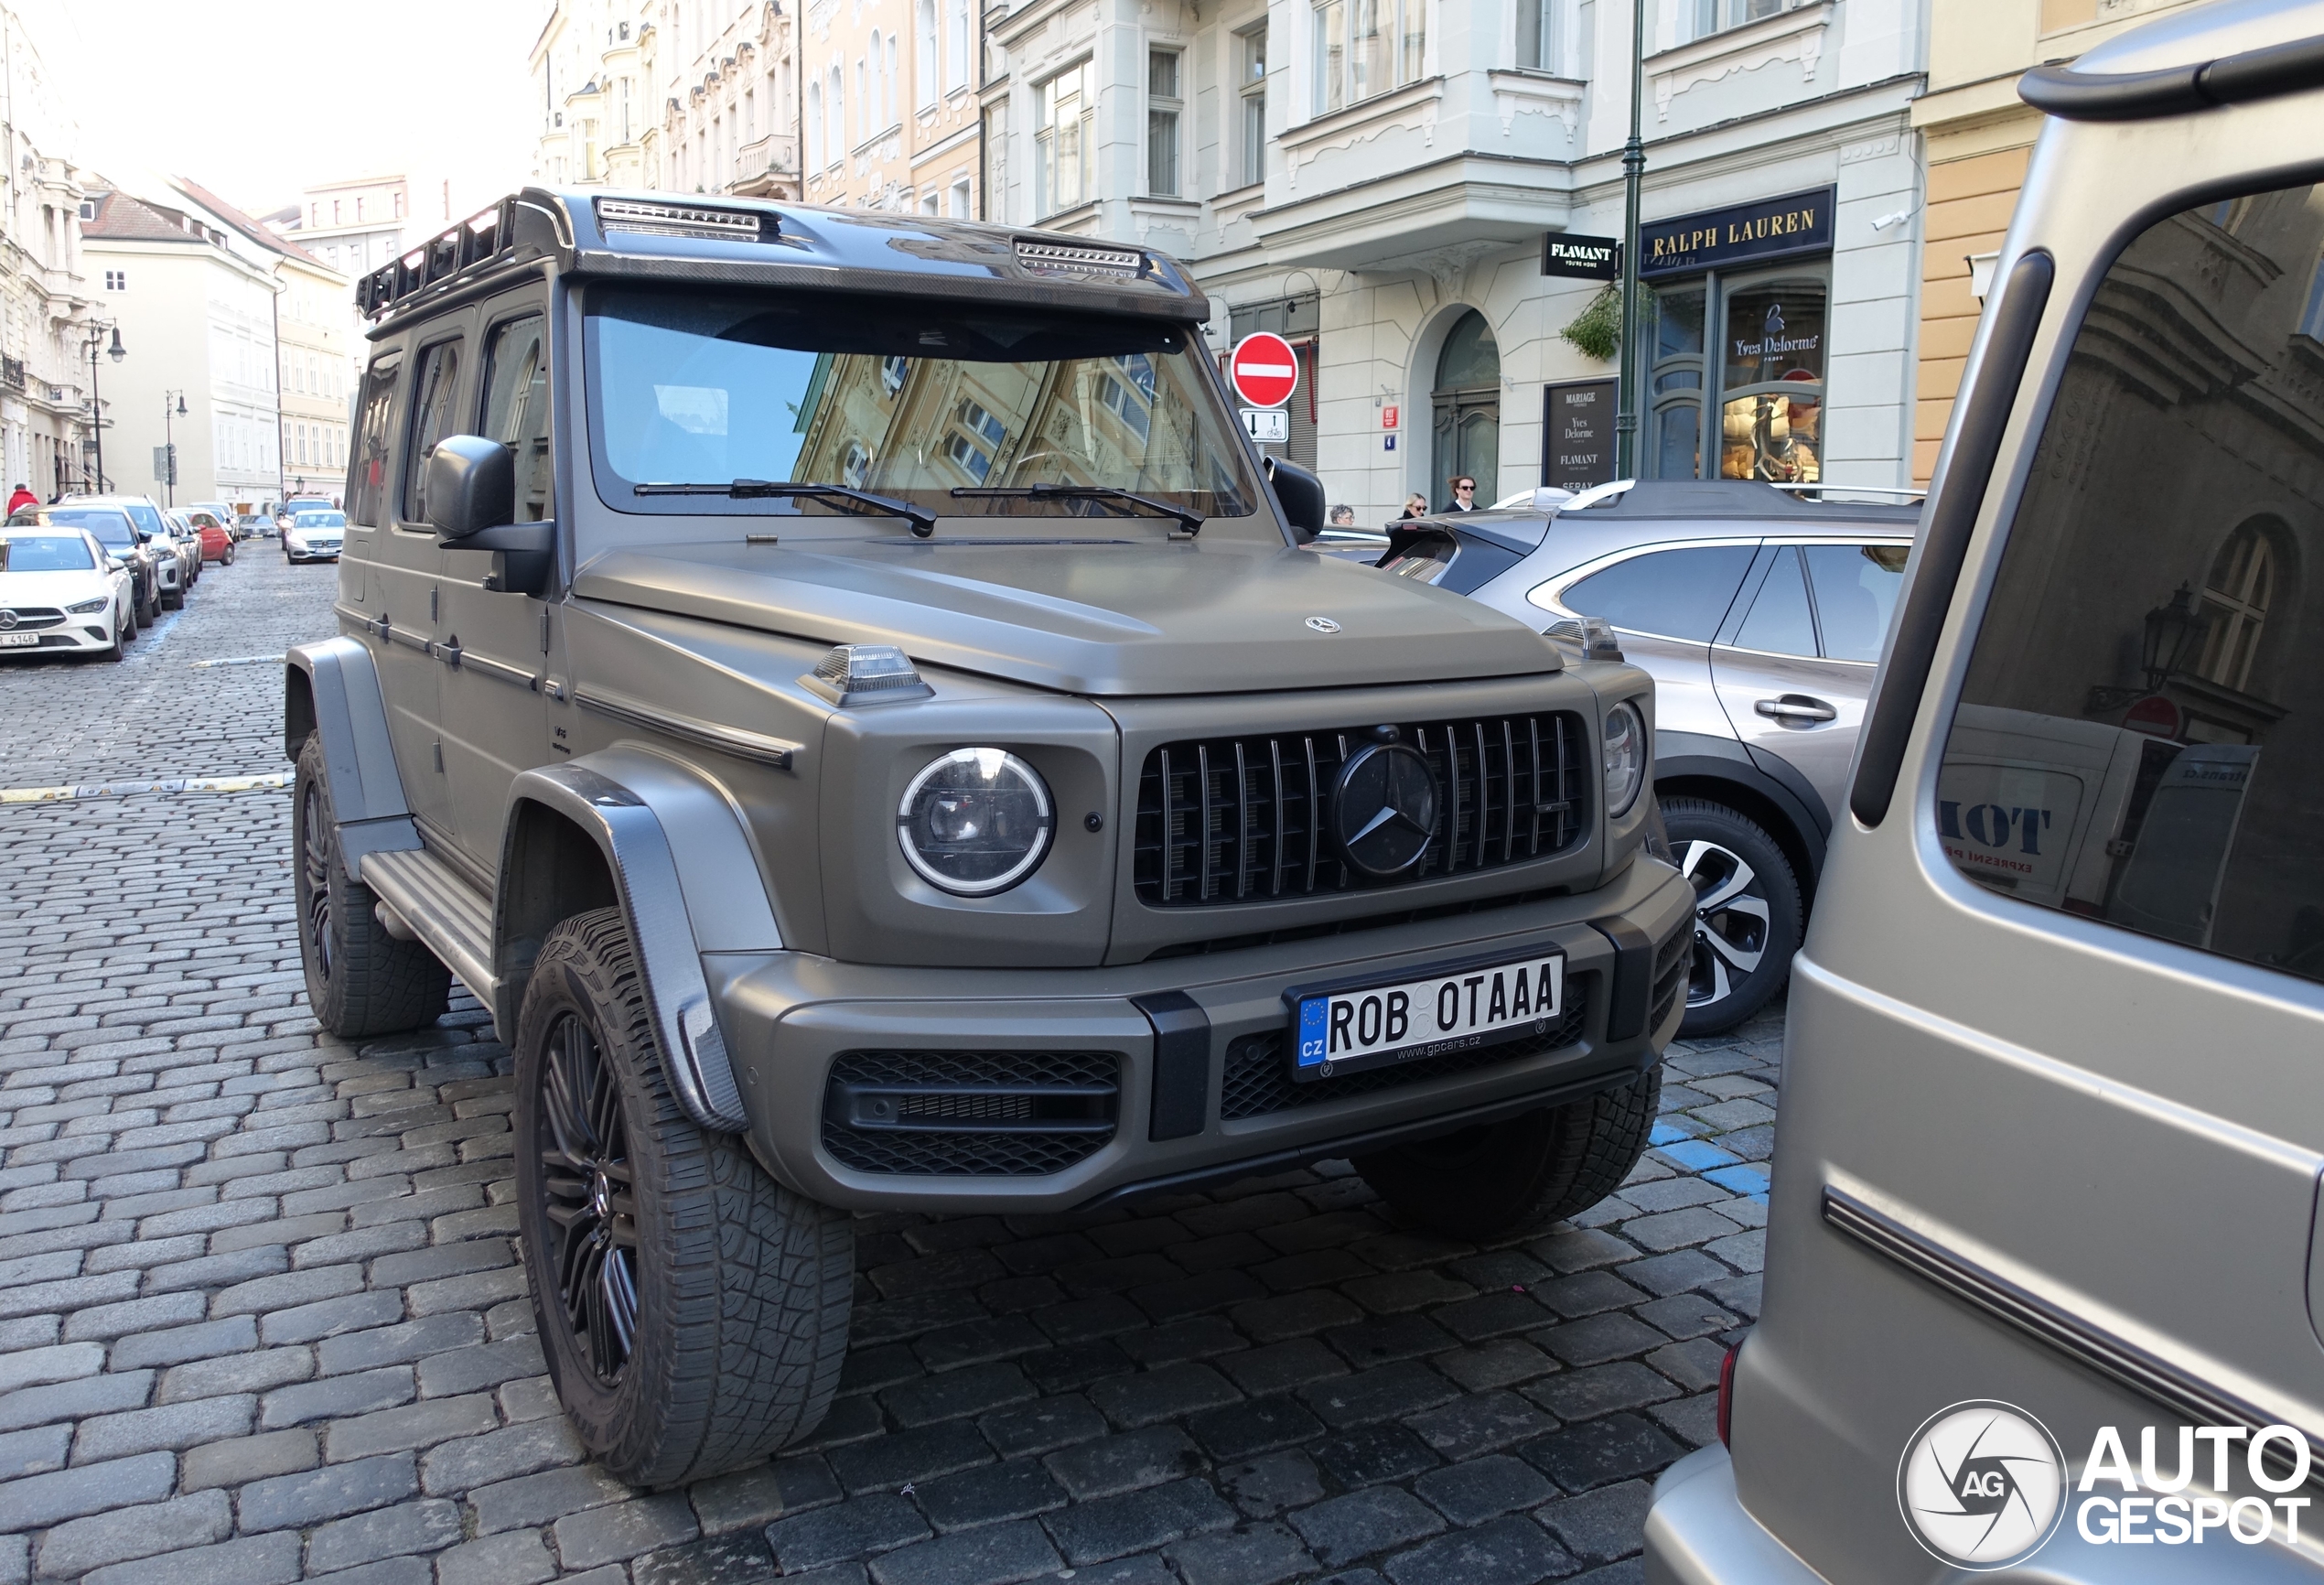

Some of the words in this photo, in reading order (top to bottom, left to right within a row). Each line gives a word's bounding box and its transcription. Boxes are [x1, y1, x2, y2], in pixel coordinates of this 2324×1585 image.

[1653, 228, 1717, 257] RALPH
[1728, 209, 1814, 243] LAUREN
[1551, 243, 1611, 261] FLAMANT
[1735, 340, 1761, 356] Yves
[1764, 335, 1817, 353] Delorme
[1565, 392, 1596, 404] MARIAGE
[1572, 417, 1587, 428] Yves
[1565, 427, 1594, 439] Delorme
[1560, 454, 1598, 465] FLAMANT
[10, 634, 35, 644] 4146
[1302, 1039, 1323, 1057] CZ
[1397, 1036, 1481, 1060] www.gpcars.cz
